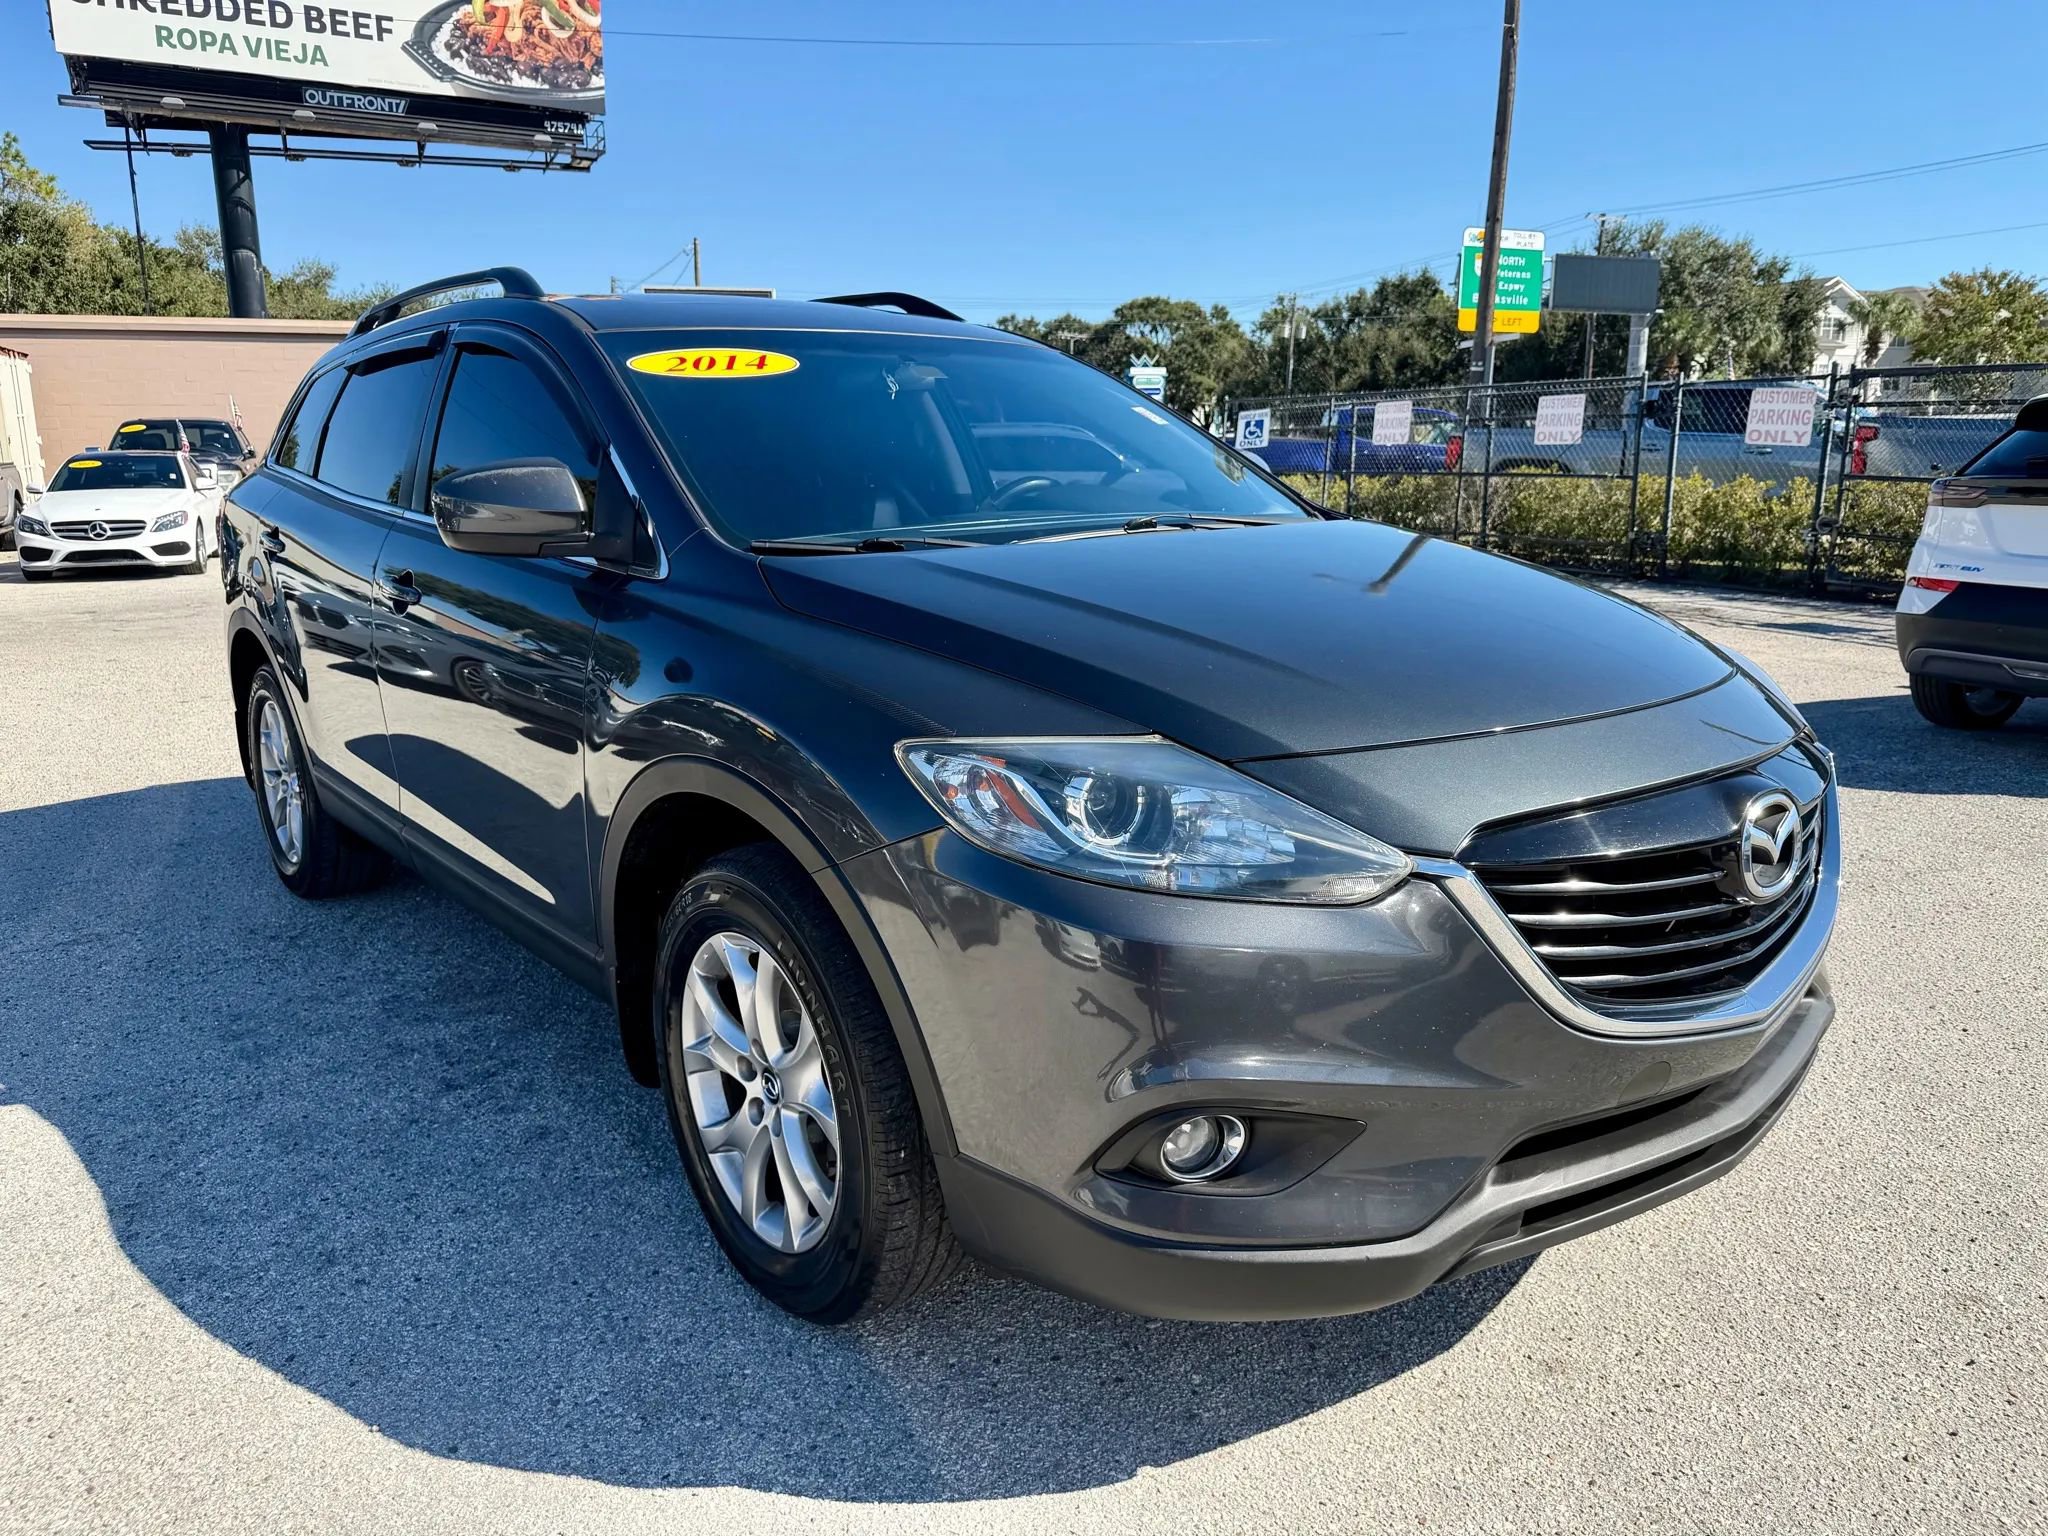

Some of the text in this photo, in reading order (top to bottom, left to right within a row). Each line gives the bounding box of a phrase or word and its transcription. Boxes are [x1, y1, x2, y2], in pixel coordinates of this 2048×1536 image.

[71, 0, 394, 42] EDDED BEEF
[154, 24, 329, 67] ROPA VIEJA
[1498, 281, 1525, 293] Expwy
[1502, 317, 1522, 327] LEFT
[665, 354, 769, 373] 2014
[1540, 396, 1584, 410] CUSTOMER
[1753, 389, 1814, 404] CUSTOMER
[1538, 412, 1581, 427] PARKING
[1750, 408, 1811, 426] PARKING
[1375, 432, 1407, 443] ONLY
[1537, 430, 1580, 442] ONLY
[1748, 429, 1808, 443] ONLY
[1239, 439, 1263, 448] ONLY
